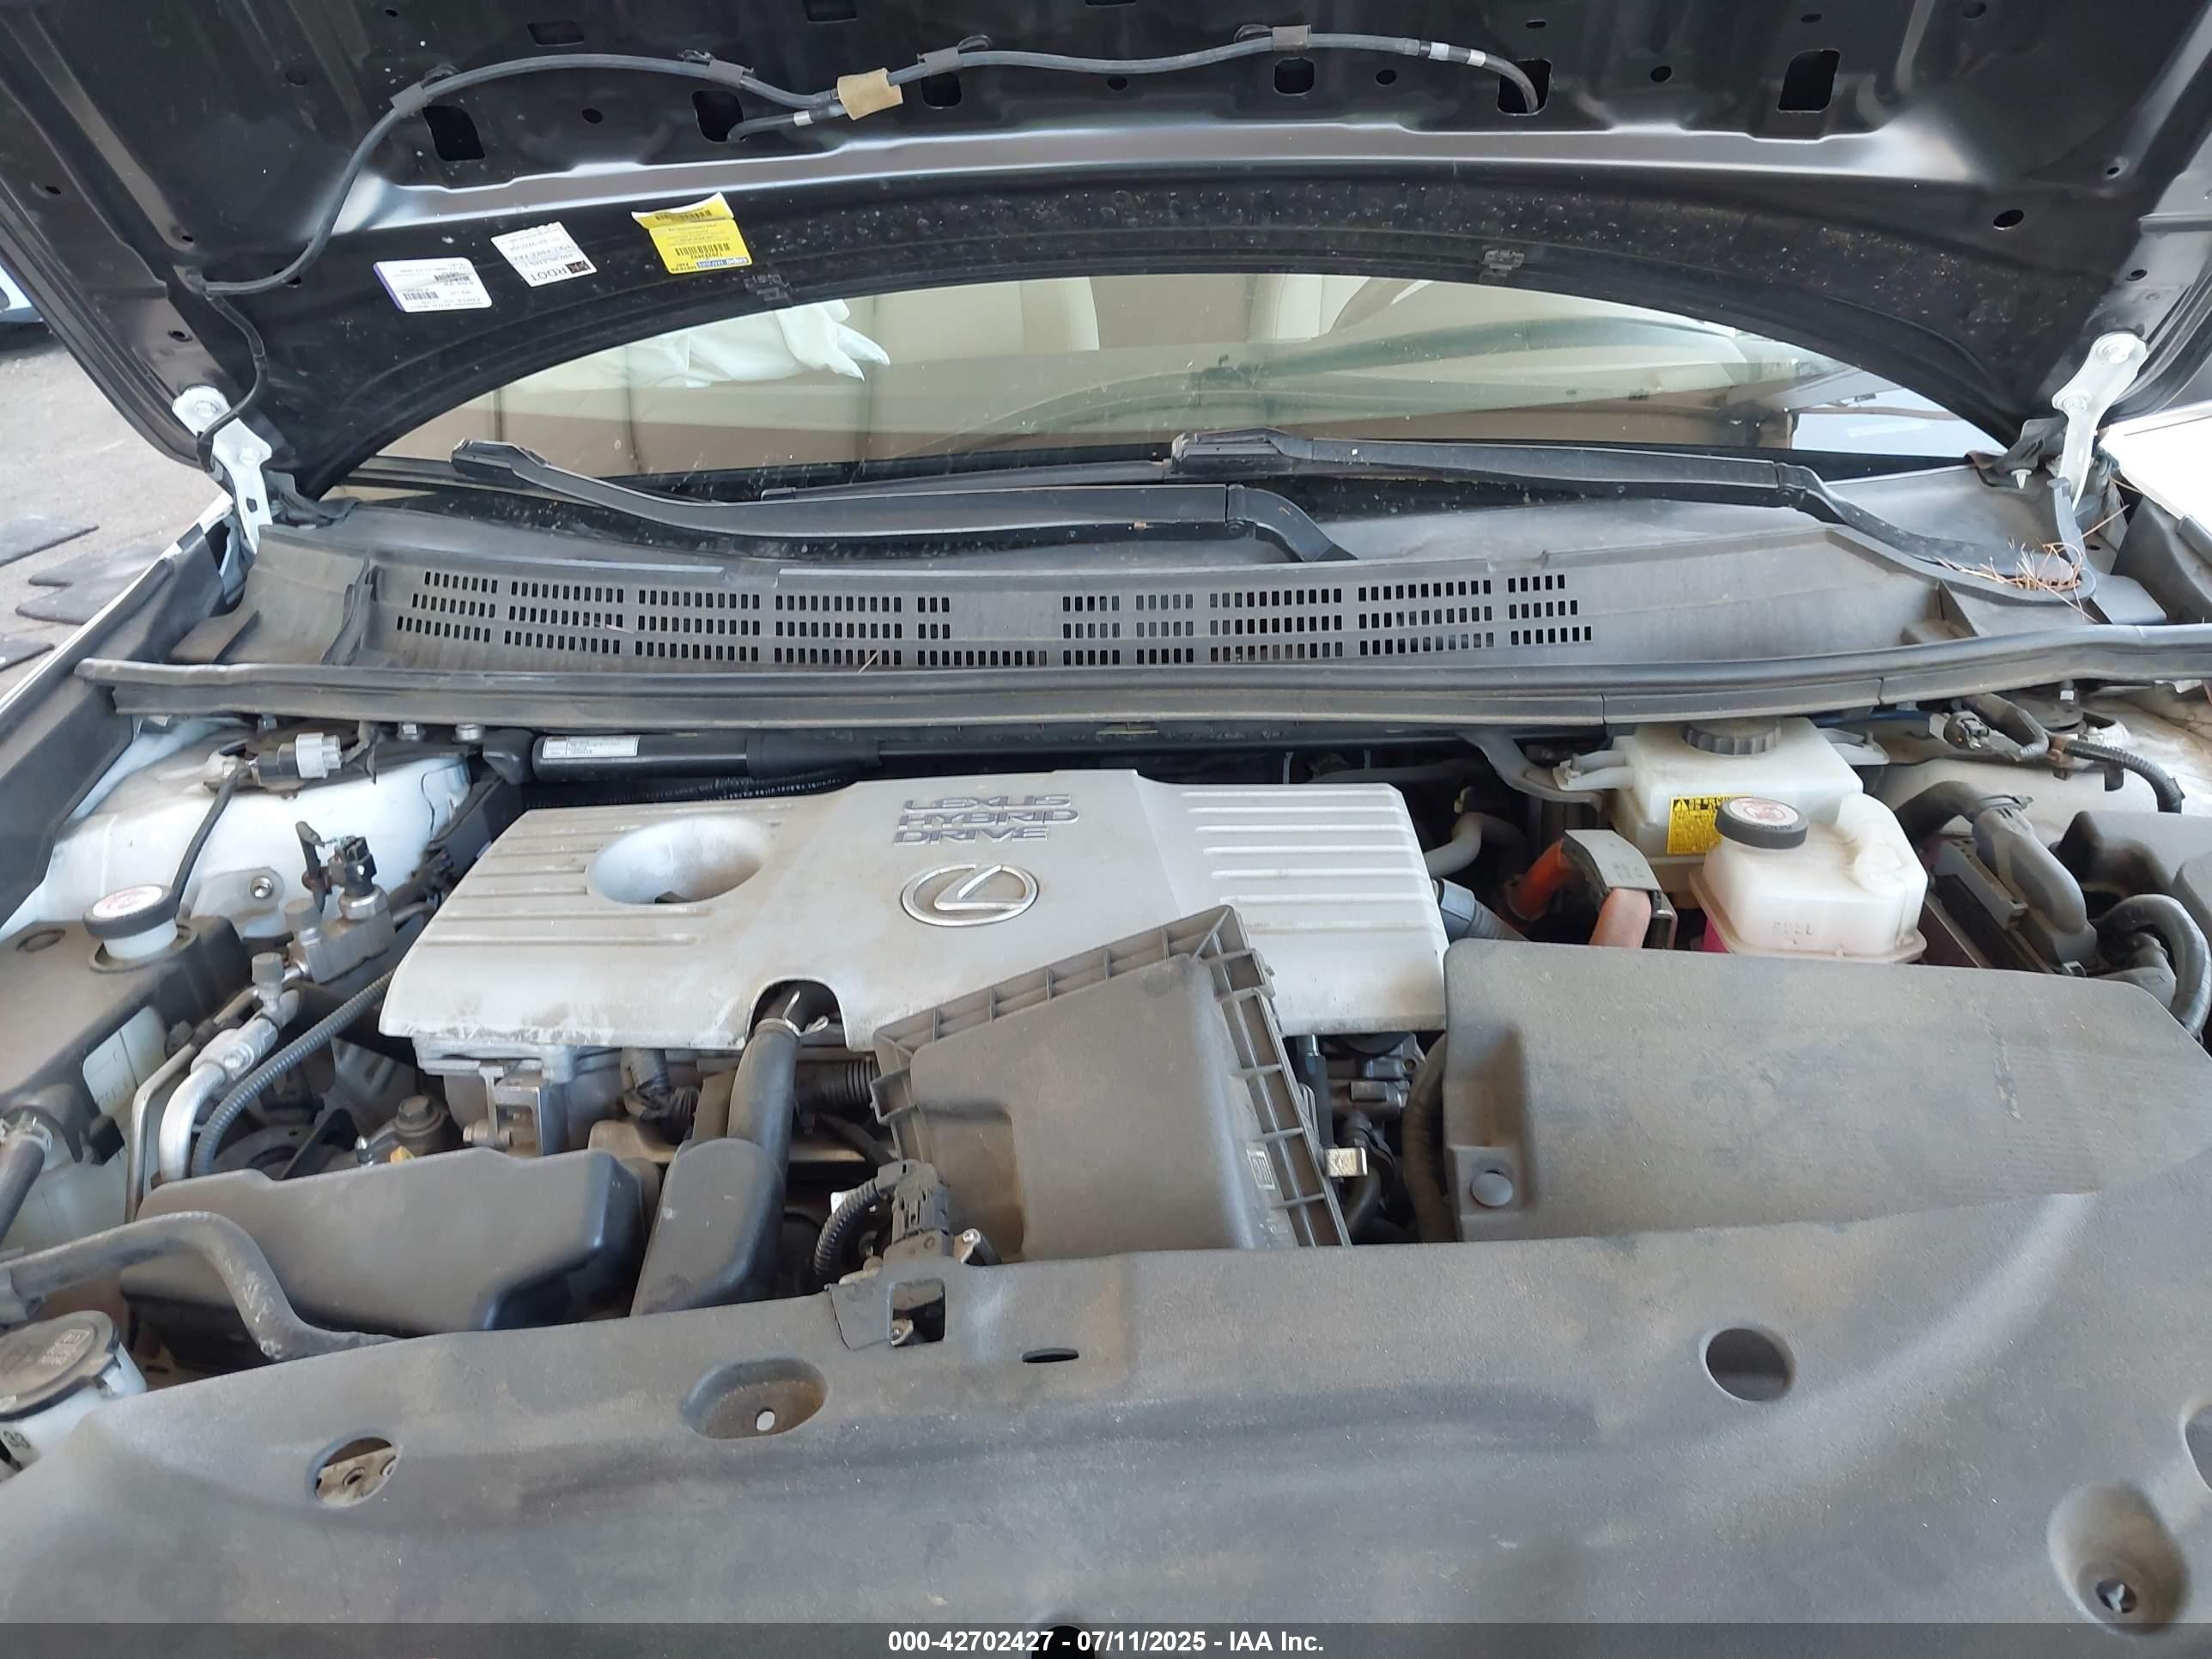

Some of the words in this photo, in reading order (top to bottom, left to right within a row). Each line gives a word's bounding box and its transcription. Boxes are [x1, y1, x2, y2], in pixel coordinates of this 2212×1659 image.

[903, 794, 1072, 812] LEXUS
[898, 810, 1079, 829] HYBRID
[893, 826, 1048, 845] DRIVE
